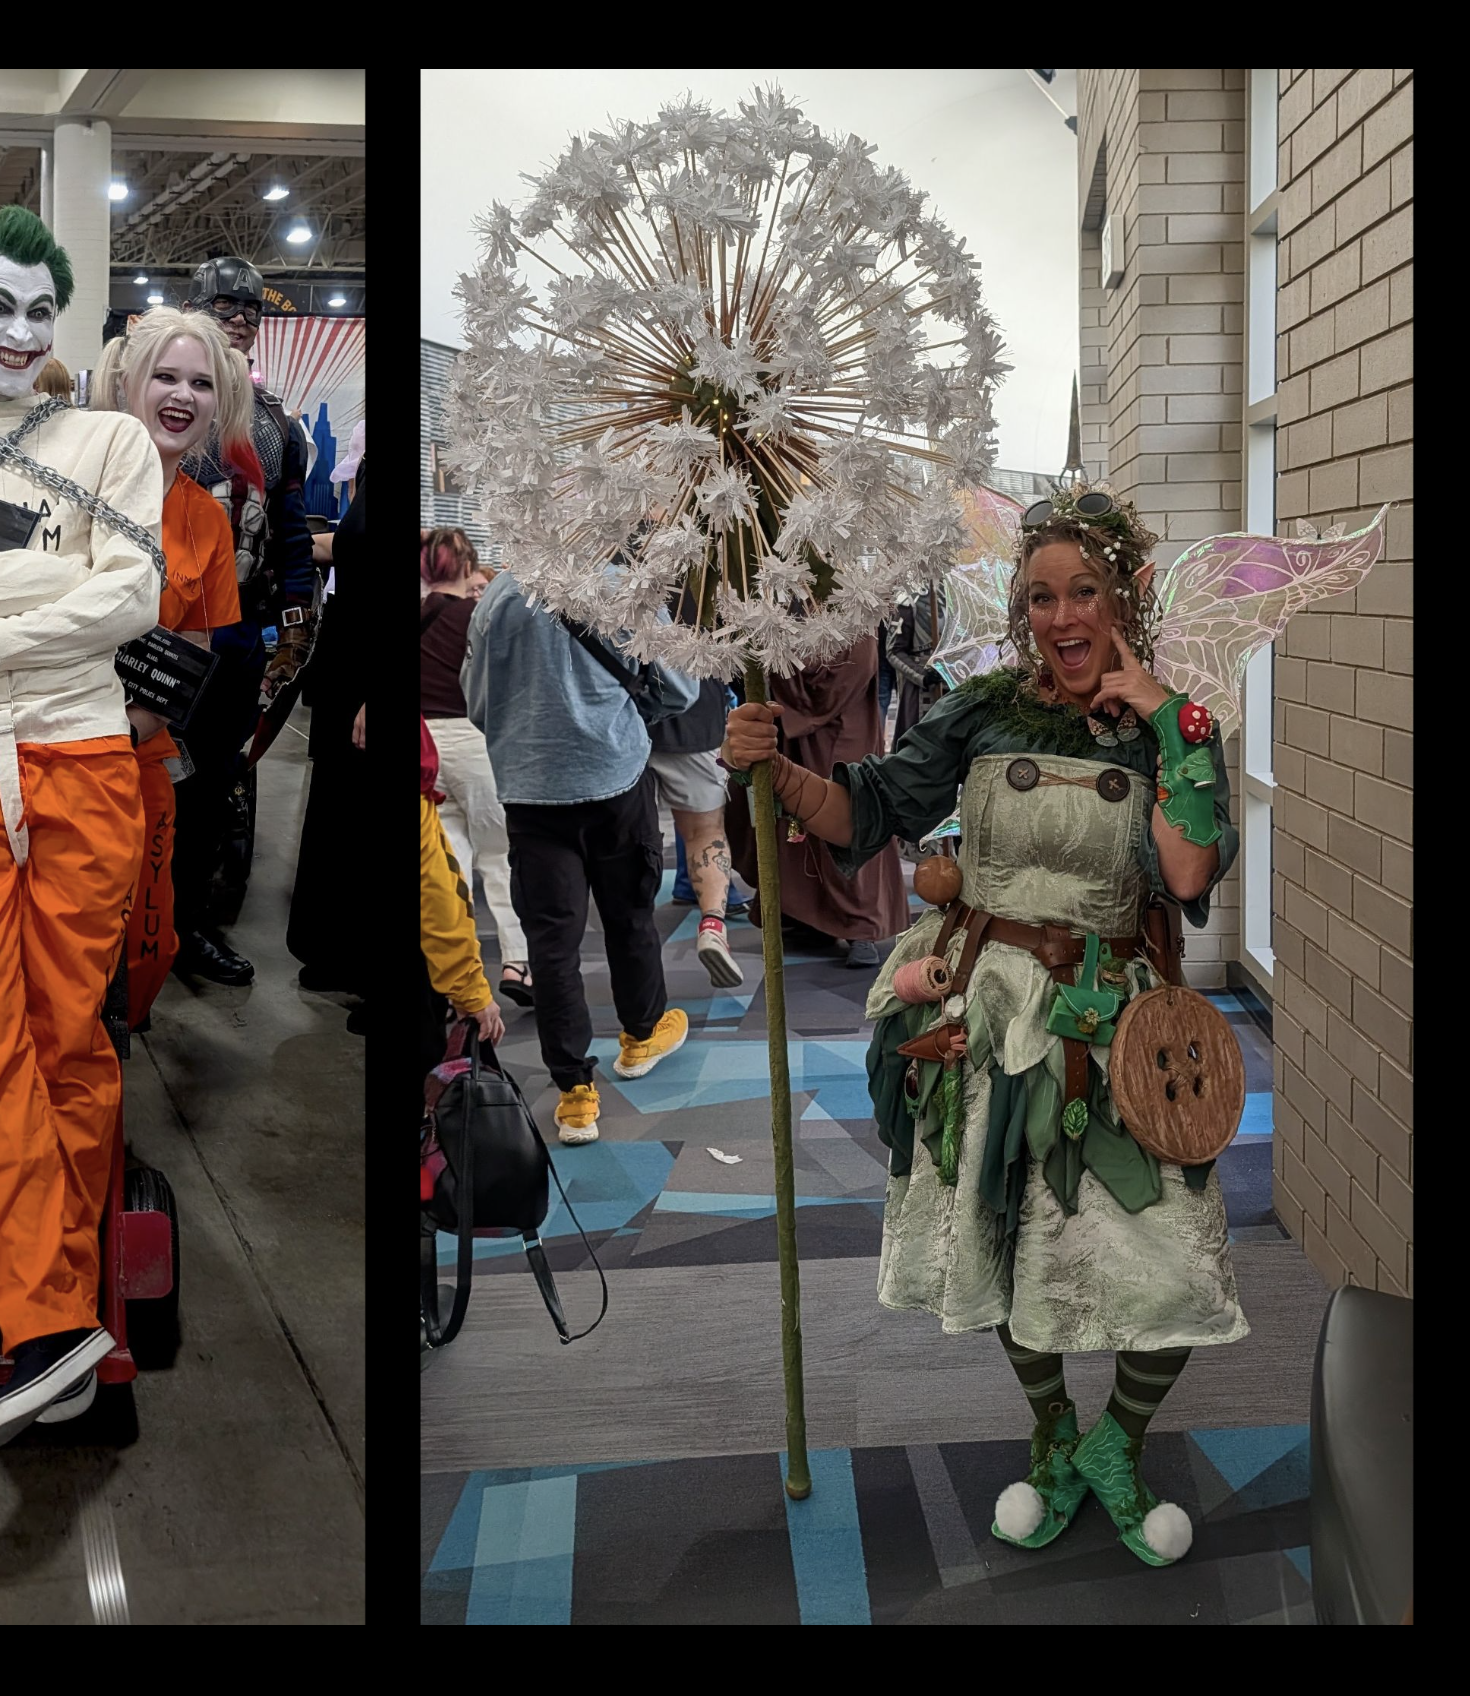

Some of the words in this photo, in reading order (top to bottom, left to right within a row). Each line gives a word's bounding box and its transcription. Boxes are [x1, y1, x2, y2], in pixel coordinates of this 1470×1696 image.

[263, 287, 283, 306] THE
[127, 681, 139, 691] CITY
[139, 686, 156, 699] POLICE
[155, 695, 169, 706] DEPT
[140, 810, 168, 961] ASYLUM
